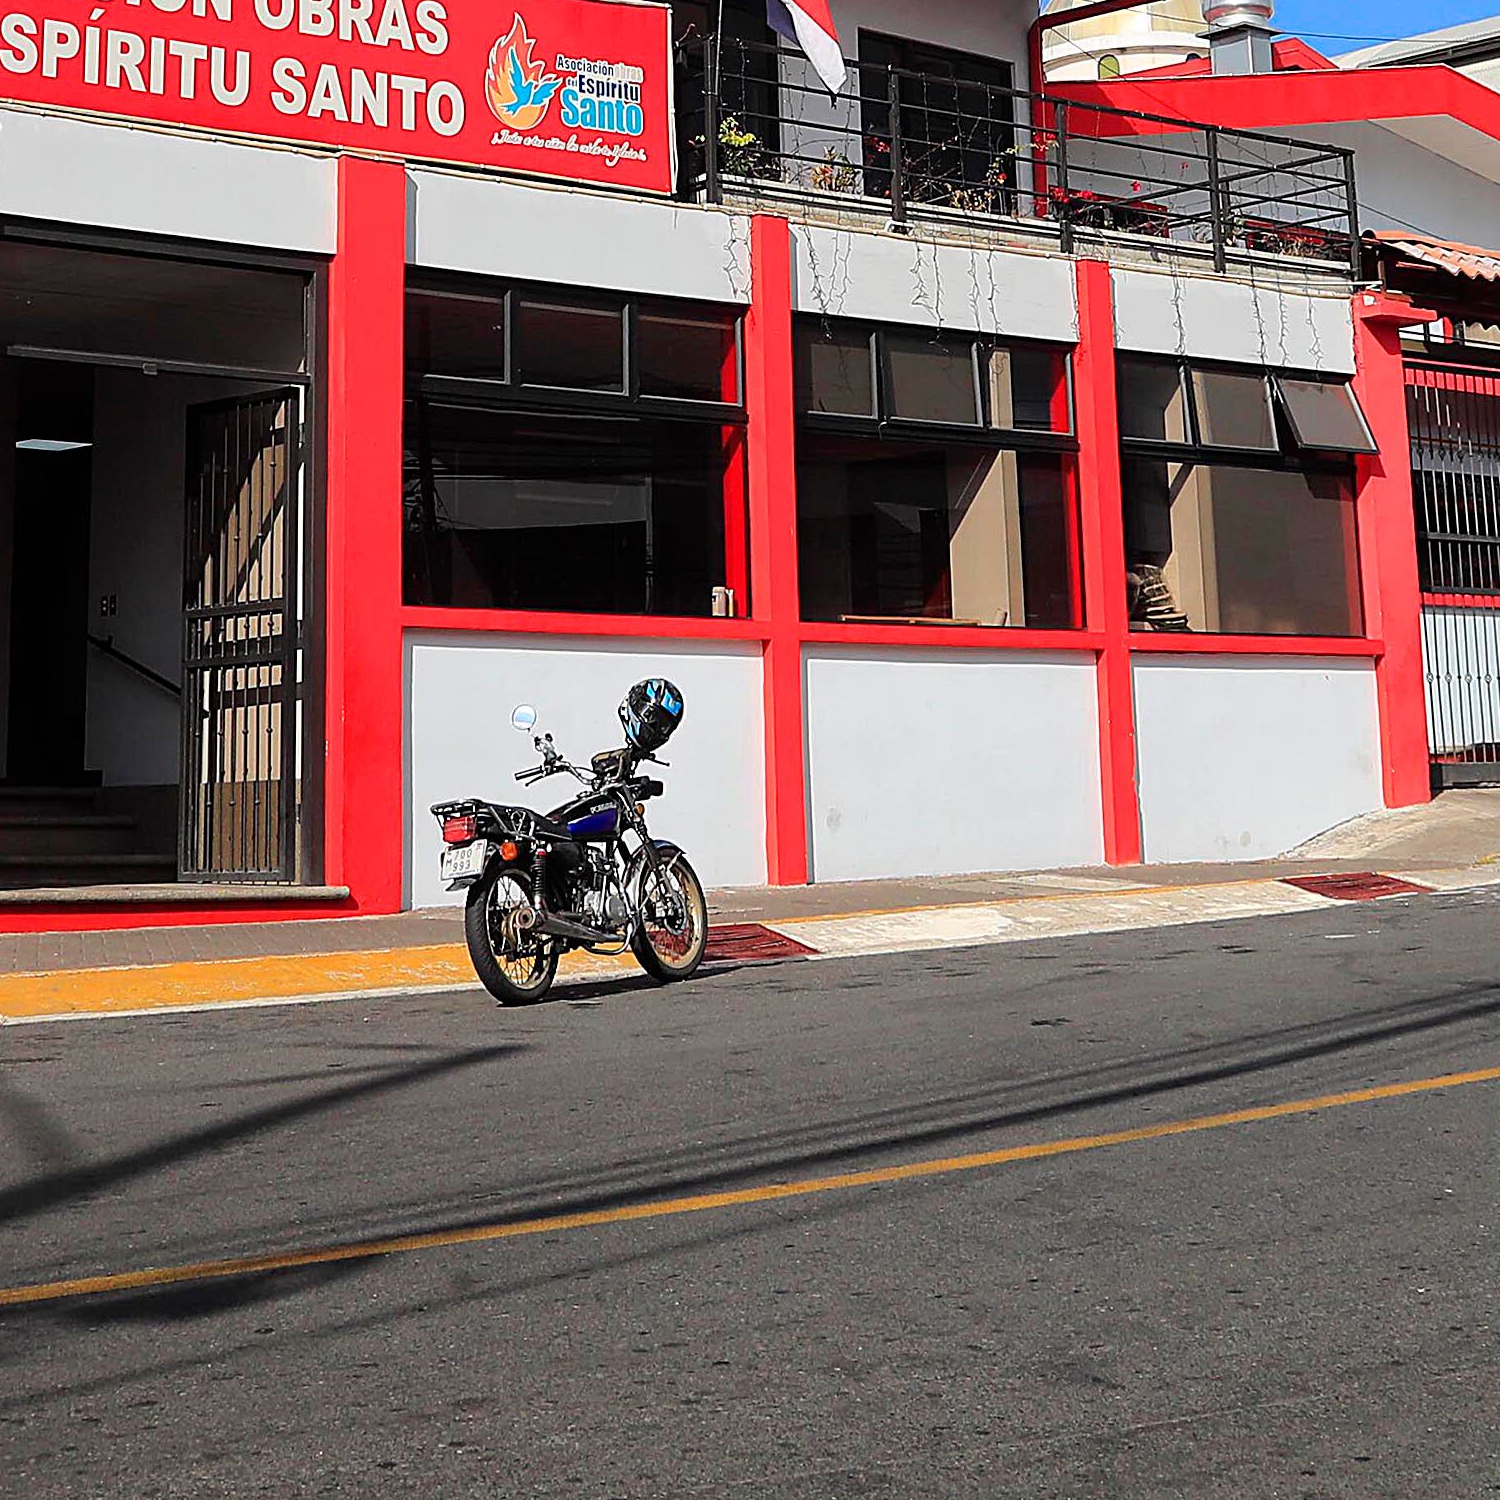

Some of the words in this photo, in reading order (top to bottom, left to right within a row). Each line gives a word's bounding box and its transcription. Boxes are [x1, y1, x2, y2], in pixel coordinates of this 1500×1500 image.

[557, 56, 614, 77] Asociación
[614, 63, 642, 81] obras
[271, 57, 466, 136] SANTO
[578, 74, 639, 102] Espíritu
[561, 88, 642, 134] Santo
